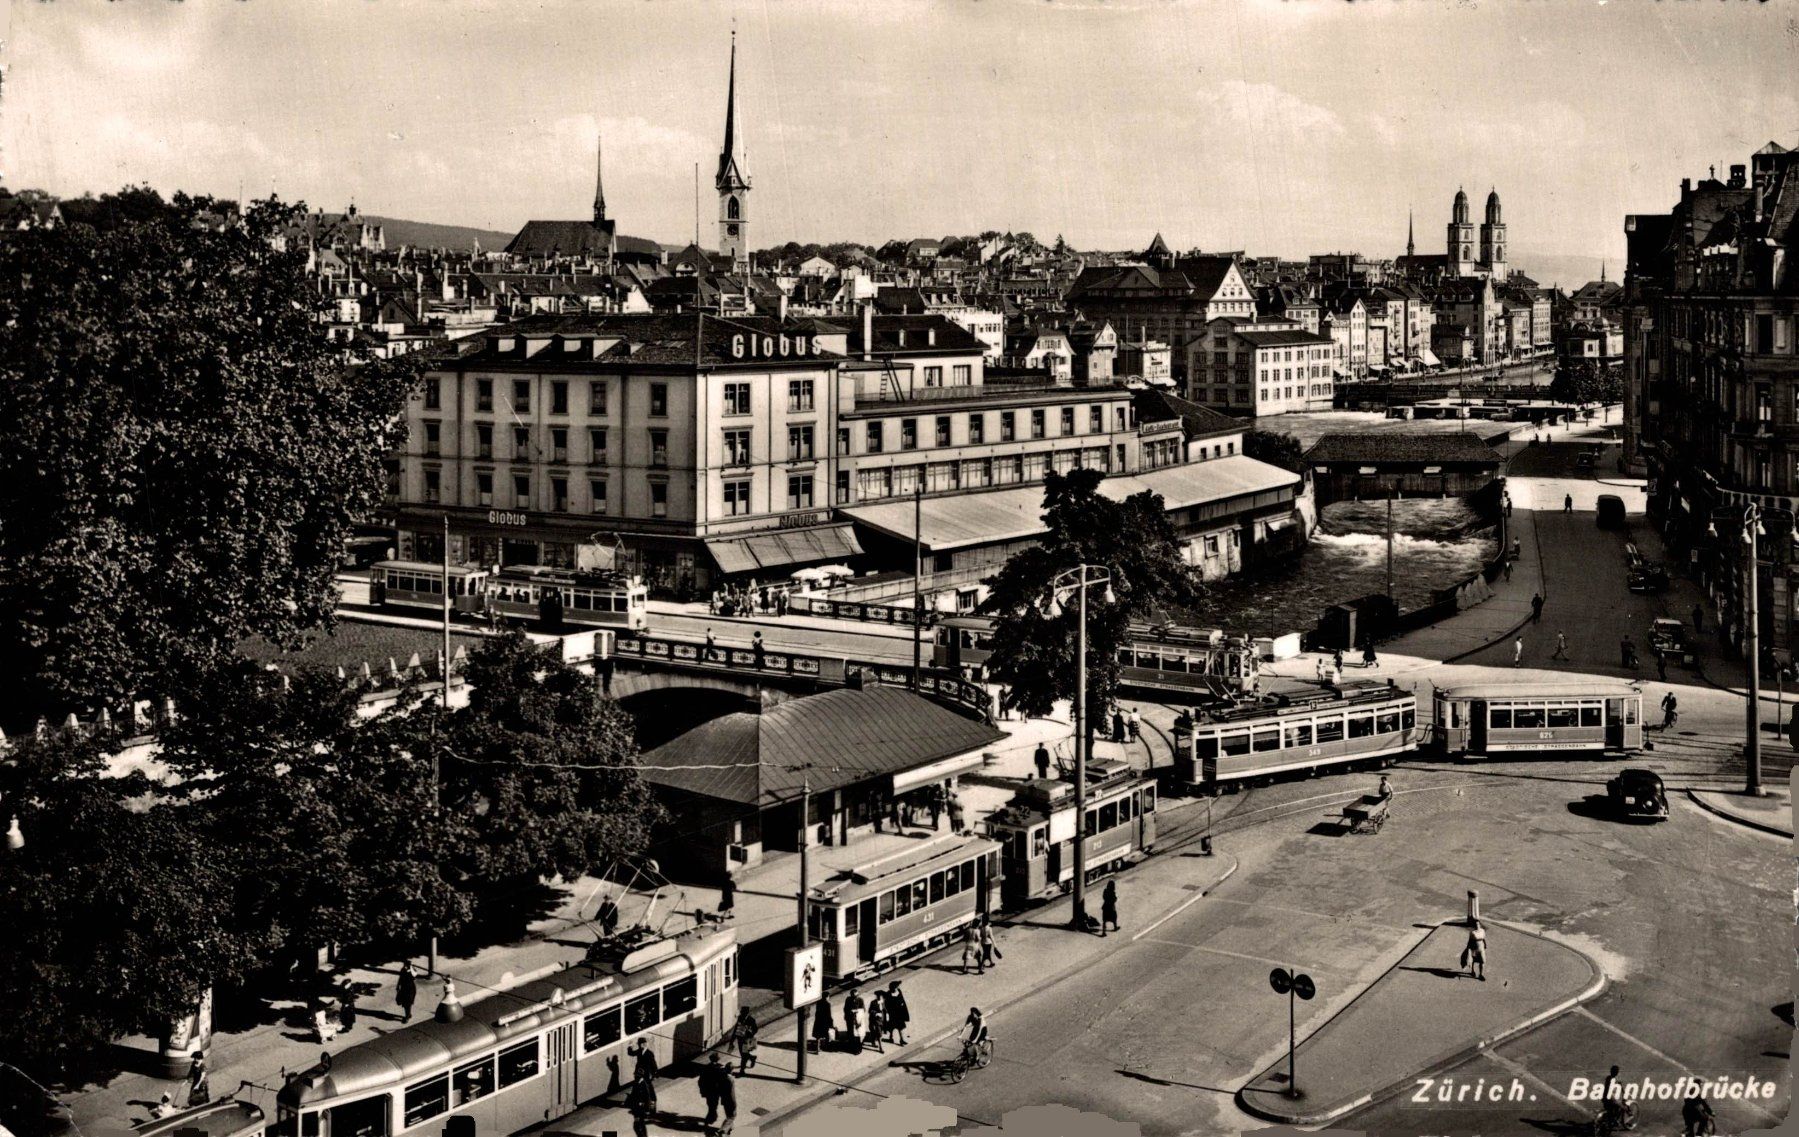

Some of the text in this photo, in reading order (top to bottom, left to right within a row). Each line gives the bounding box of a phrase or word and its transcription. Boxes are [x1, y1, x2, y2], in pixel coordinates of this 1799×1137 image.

[732, 333, 822, 358] Globus
[489, 510, 527, 526] Globus
[923, 911, 934, 923] 431
